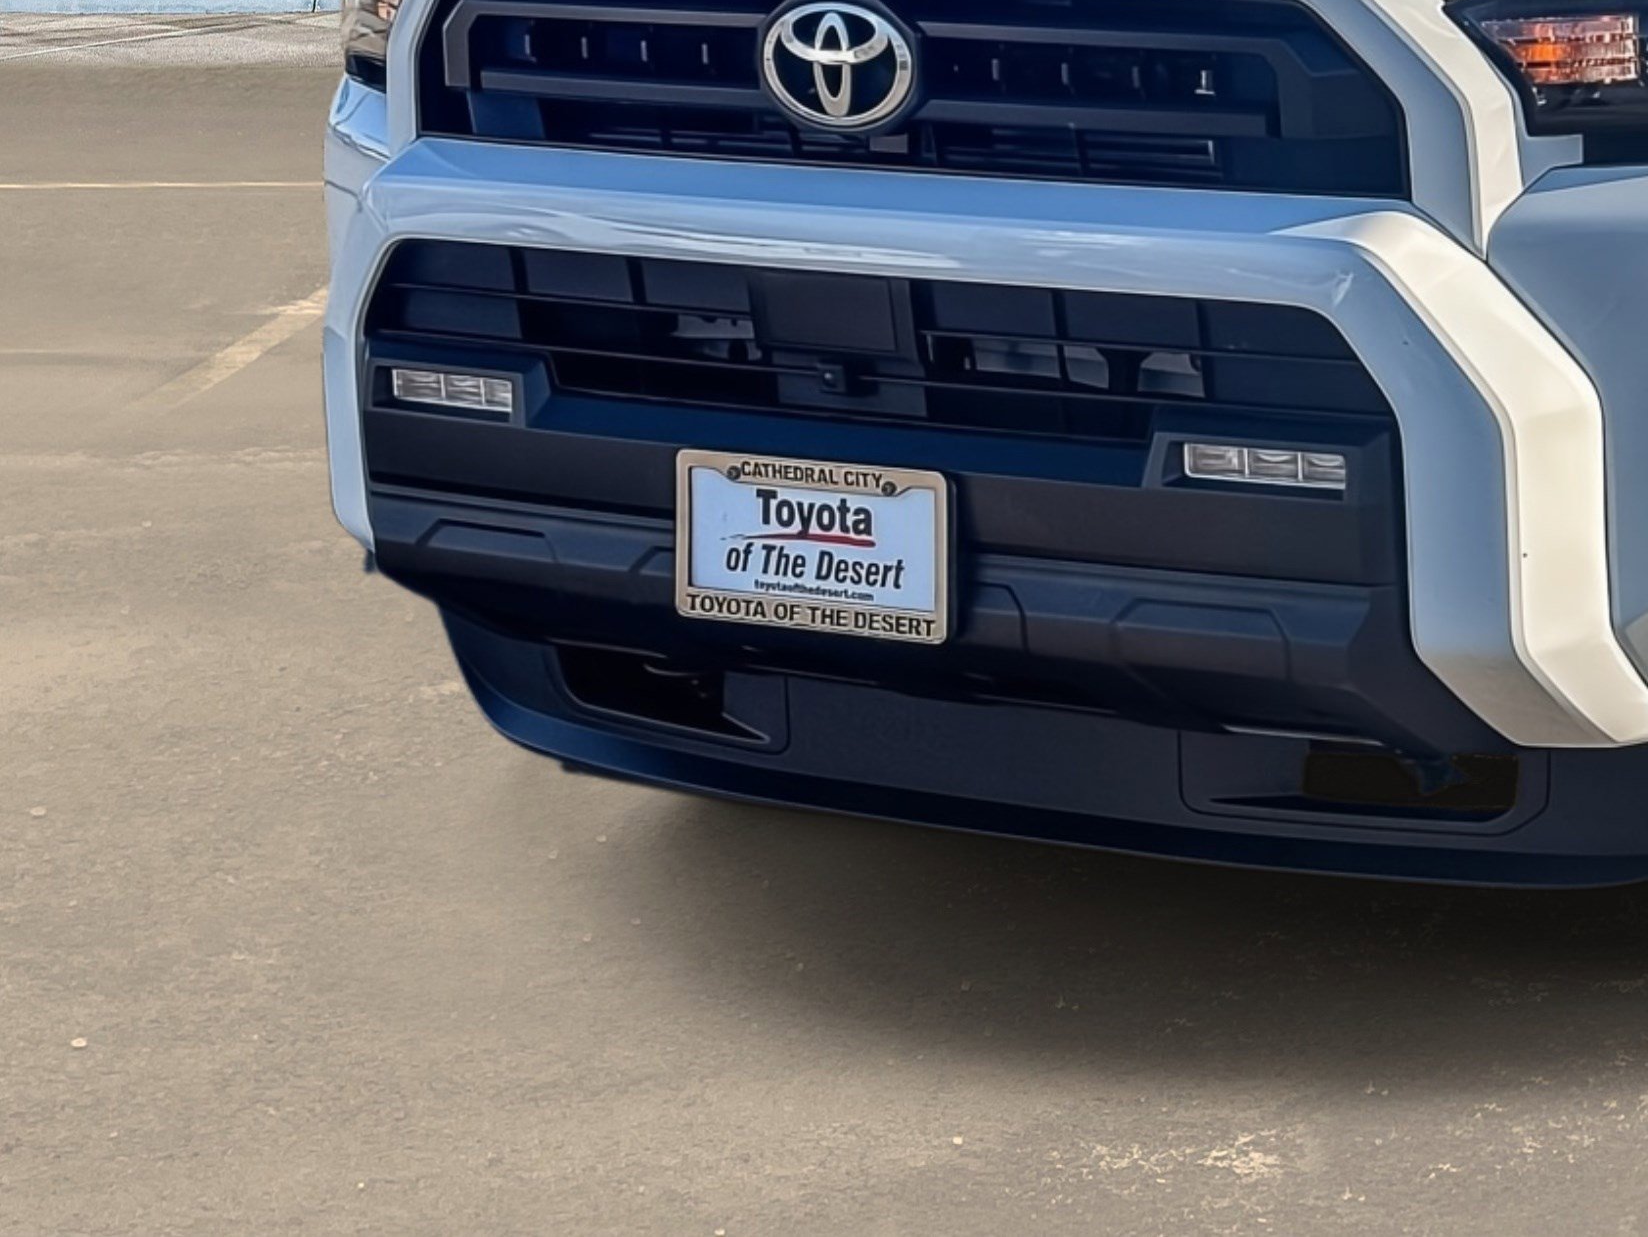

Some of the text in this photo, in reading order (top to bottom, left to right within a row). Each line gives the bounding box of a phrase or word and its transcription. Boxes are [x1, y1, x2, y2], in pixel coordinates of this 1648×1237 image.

[740, 460, 883, 489] CATHEDRAL CITY
[756, 488, 873, 538] Toyota
[726, 542, 906, 590] of The Desert
[686, 593, 937, 637] TOYOTA OF THE DESERT
